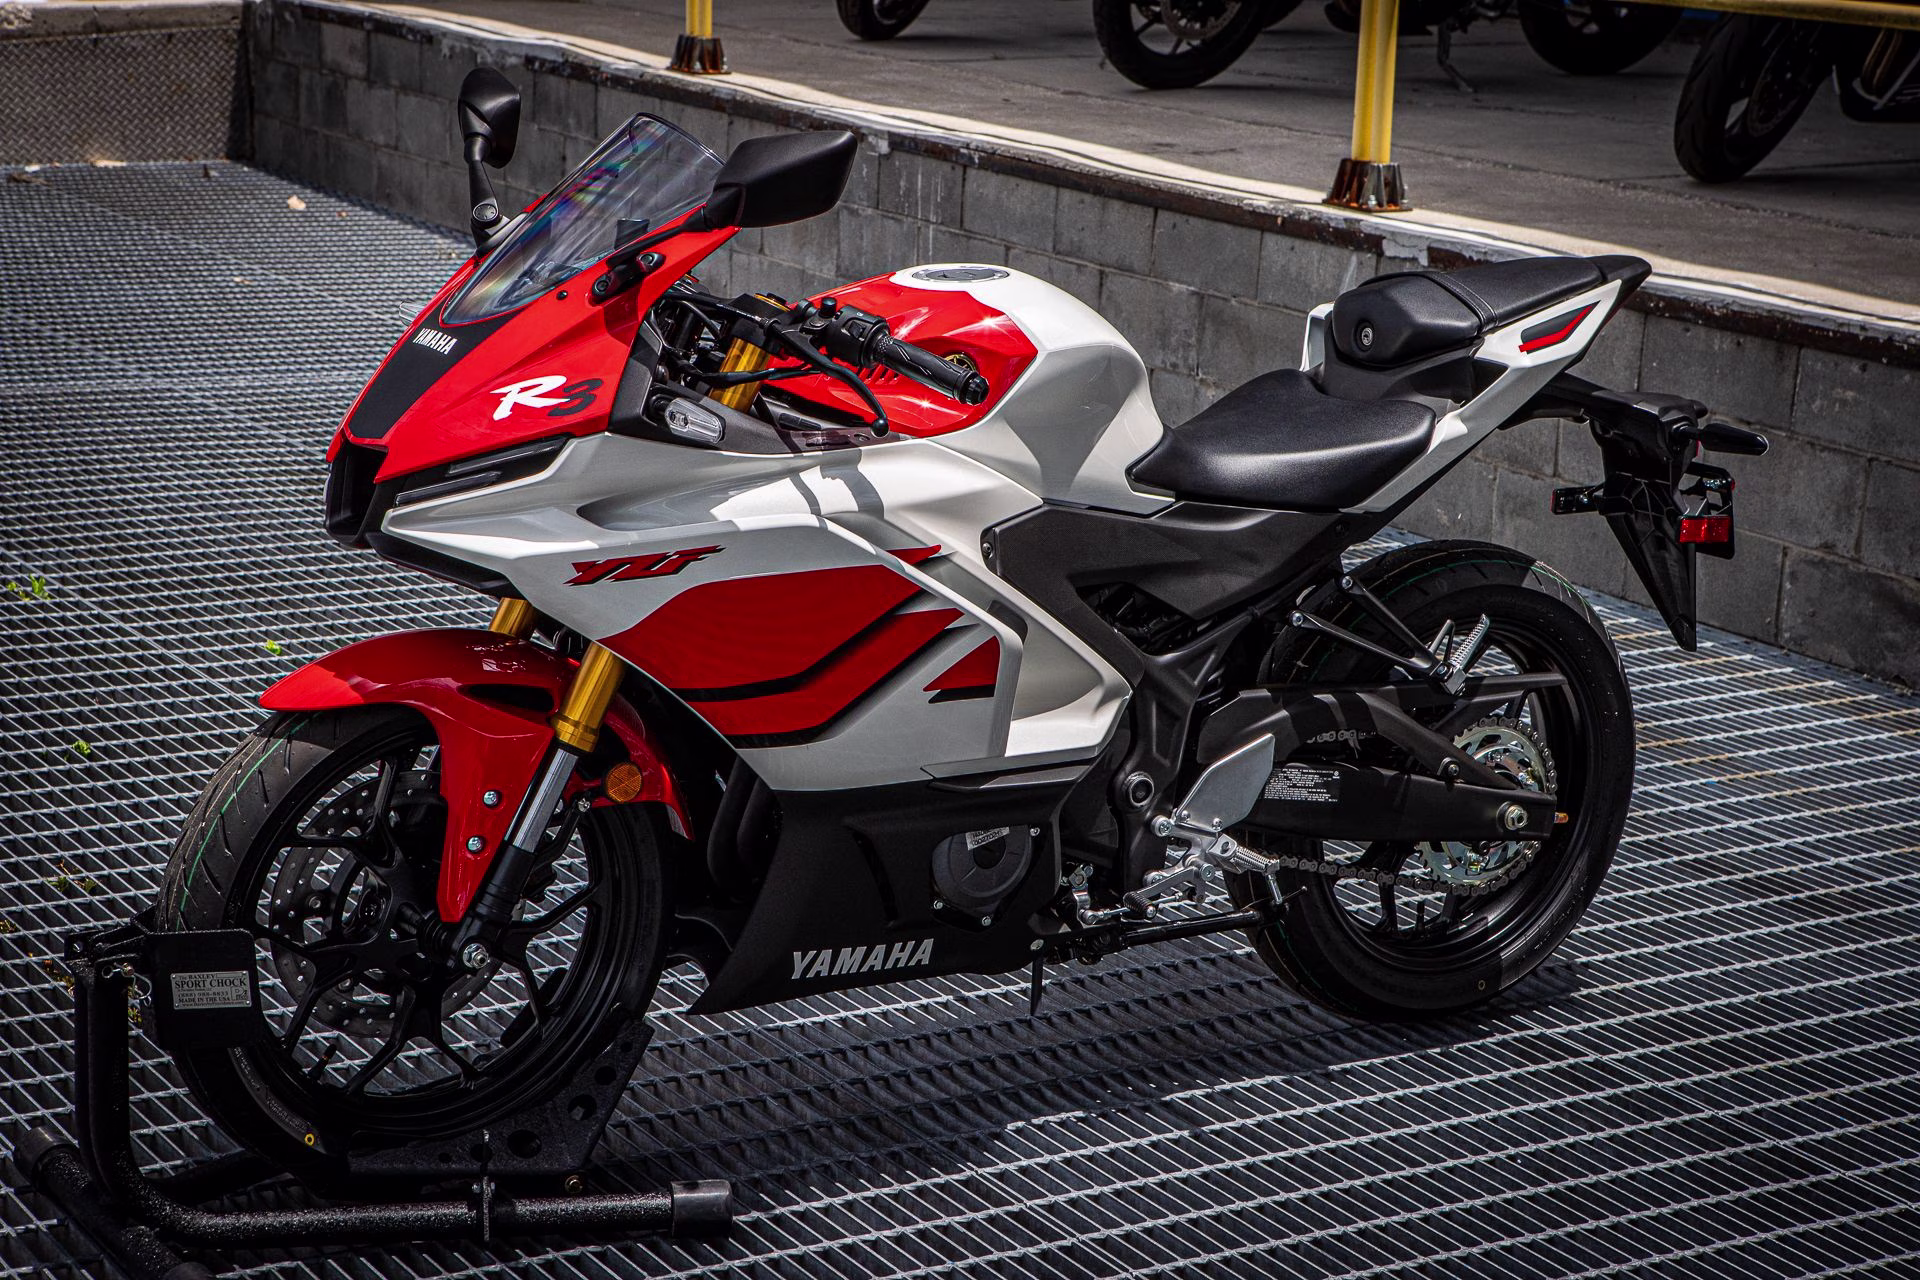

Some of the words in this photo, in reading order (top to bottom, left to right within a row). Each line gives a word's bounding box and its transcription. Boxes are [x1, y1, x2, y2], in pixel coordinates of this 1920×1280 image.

[413, 327, 458, 355] YAMAHA
[489, 375, 604, 422] R3
[562, 544, 727, 586] YZF
[791, 938, 935, 980] YAMAHA
[174, 979, 208, 989] SPORT
[209, 978, 247, 987] CHOCK
